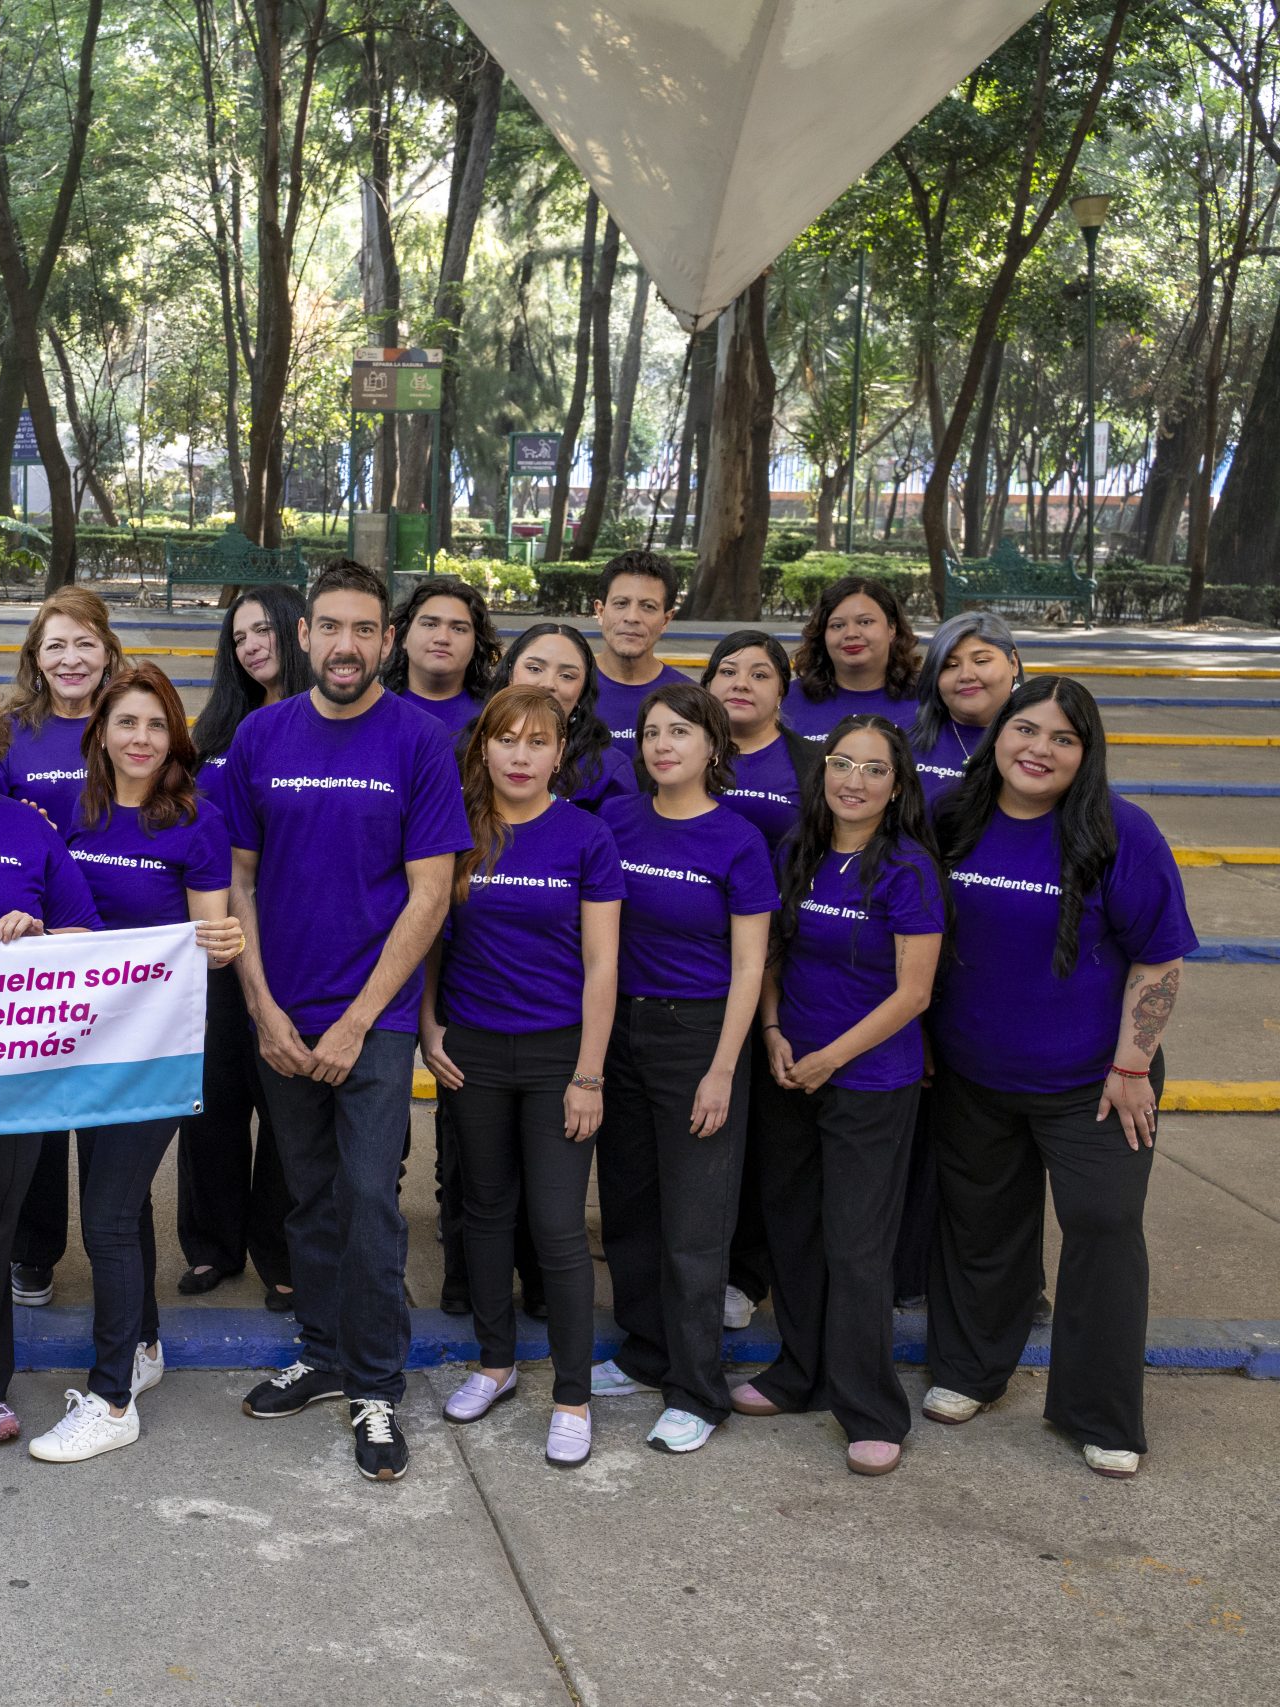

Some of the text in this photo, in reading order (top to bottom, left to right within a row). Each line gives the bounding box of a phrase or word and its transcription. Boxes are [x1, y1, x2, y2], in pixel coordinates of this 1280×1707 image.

[271, 776, 395, 793] Desobedientes Inc.
[768, 791, 791, 804] Inc.
[140, 858, 166, 870] Inc.
[547, 877, 571, 888] Inc.
[685, 870, 712, 884] Inc.
[841, 907, 869, 920] Inc.
[84, 960, 173, 988] solas,
